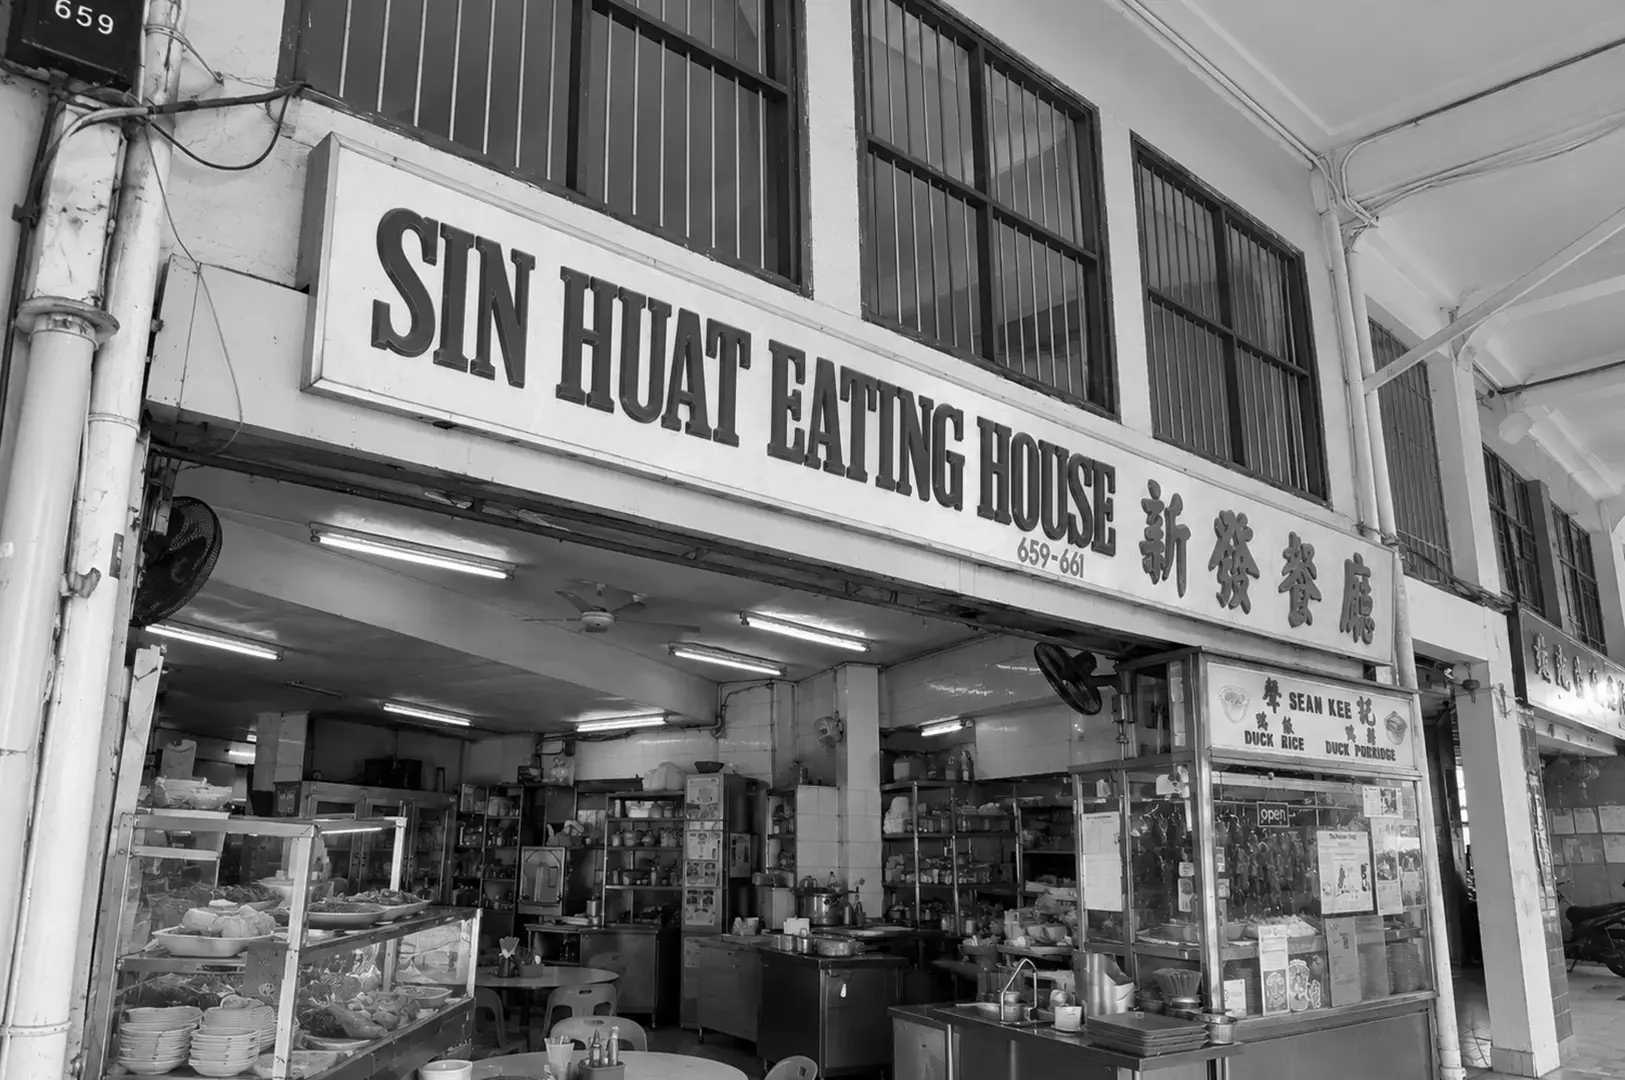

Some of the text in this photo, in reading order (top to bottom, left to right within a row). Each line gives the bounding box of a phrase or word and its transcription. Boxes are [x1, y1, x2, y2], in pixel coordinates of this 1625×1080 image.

[55, 0, 114, 35] 659
[371, 208, 1117, 558] SIN HUAT EATING HOUSE
[1017, 536, 1085, 579] 659-661
[1138, 478, 1376, 646] 新發餐廳
[1289, 691, 1323, 715] SEAN
[1328, 698, 1352, 720] KEE
[1244, 730, 1305, 751] DUCK RICE
[1325, 740, 1396, 762] DUCK PORRIDGE
